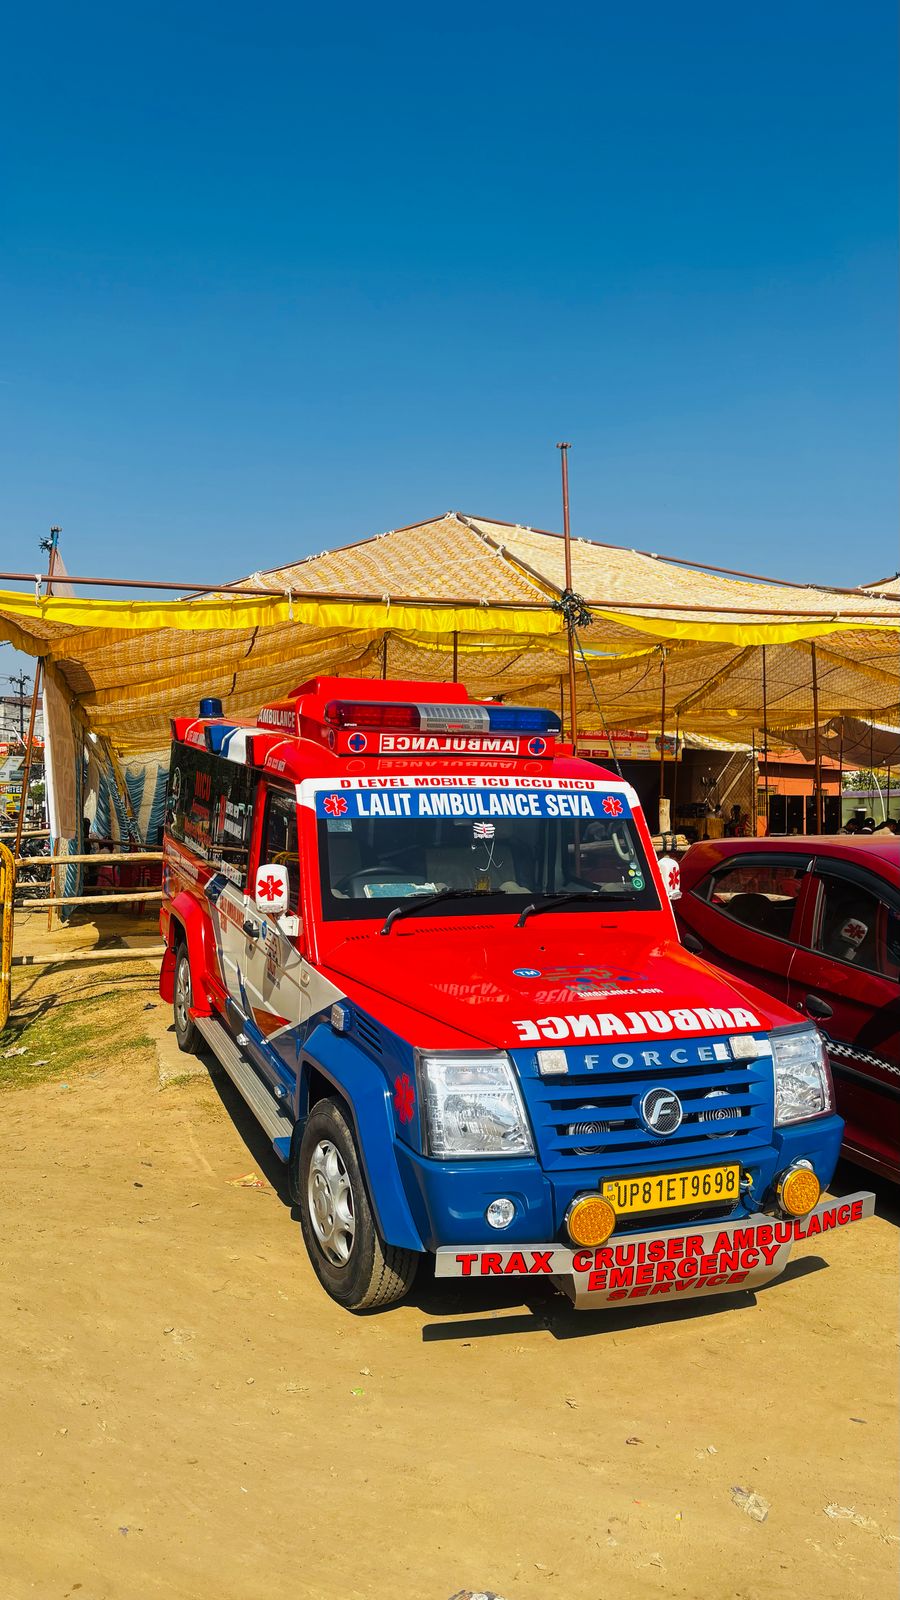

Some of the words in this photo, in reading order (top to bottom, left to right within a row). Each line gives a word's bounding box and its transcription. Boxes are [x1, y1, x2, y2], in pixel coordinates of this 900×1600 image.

[258, 708, 296, 728] AMBULANCE
[340, 779, 352, 788] D
[358, 778, 409, 788] LEVEL
[414, 777, 476, 787] MOBILE
[482, 778, 510, 787] ICU
[515, 778, 553, 788] ICCU
[558, 780, 595, 789] NICU
[355, 793, 412, 816] LALIT
[418, 793, 541, 816] AMBULANCE
[546, 794, 595, 817] SEVA
[584, 1046, 714, 1070] FORCE
[617, 1170, 735, 1208] UP81ET9698
[456, 1251, 555, 1276] TRAX
[572, 1234, 705, 1272] CRUISER
[713, 1200, 863, 1253] AMBULANCE
[587, 1244, 782, 1292] EMERGENCY
[606, 1270, 750, 1302] SERVICE
